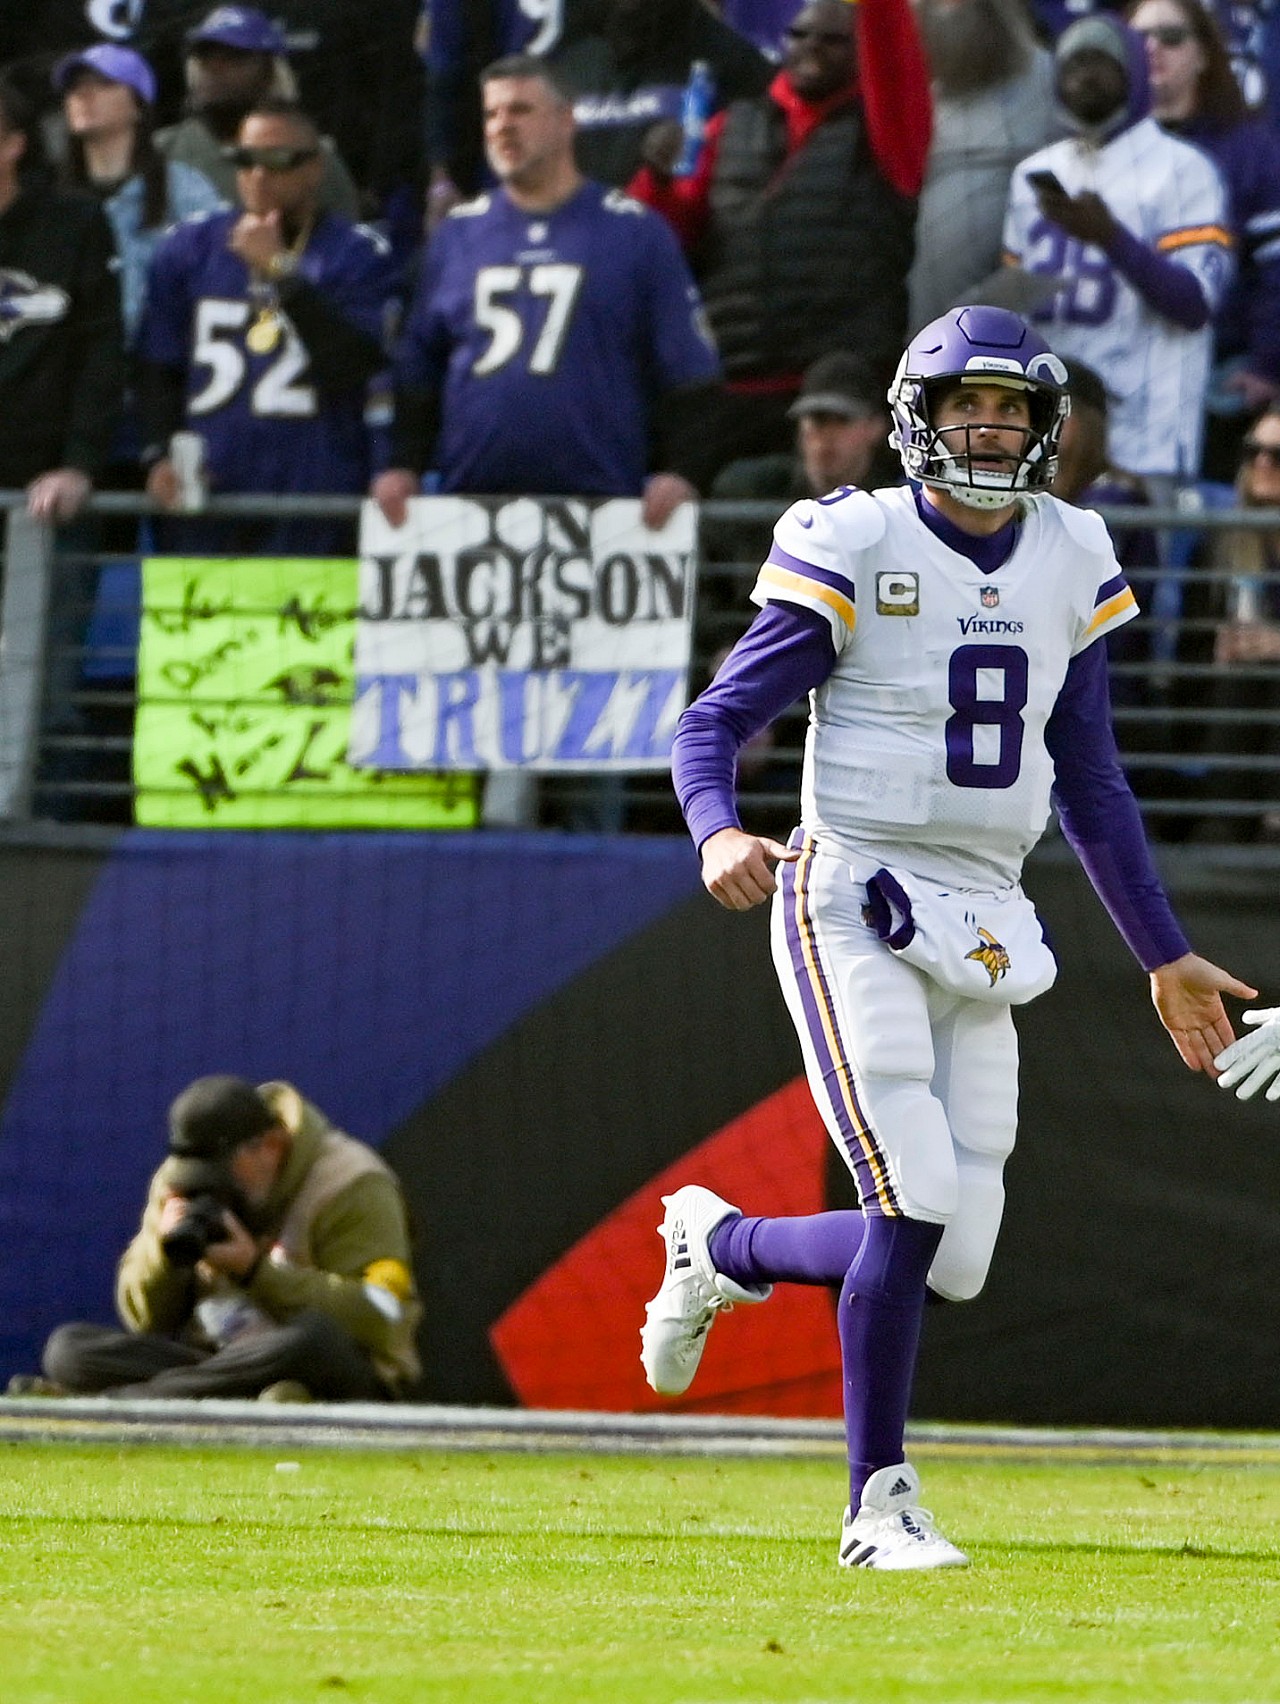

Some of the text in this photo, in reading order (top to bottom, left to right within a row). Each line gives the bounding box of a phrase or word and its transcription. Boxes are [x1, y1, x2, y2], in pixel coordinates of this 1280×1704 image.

[187, 298, 318, 416] 52
[472, 263, 583, 377] 57
[357, 553, 691, 625] JACKSON
[878, 573, 918, 605] C
[464, 614, 571, 669] WE
[945, 644, 1029, 789] 8
